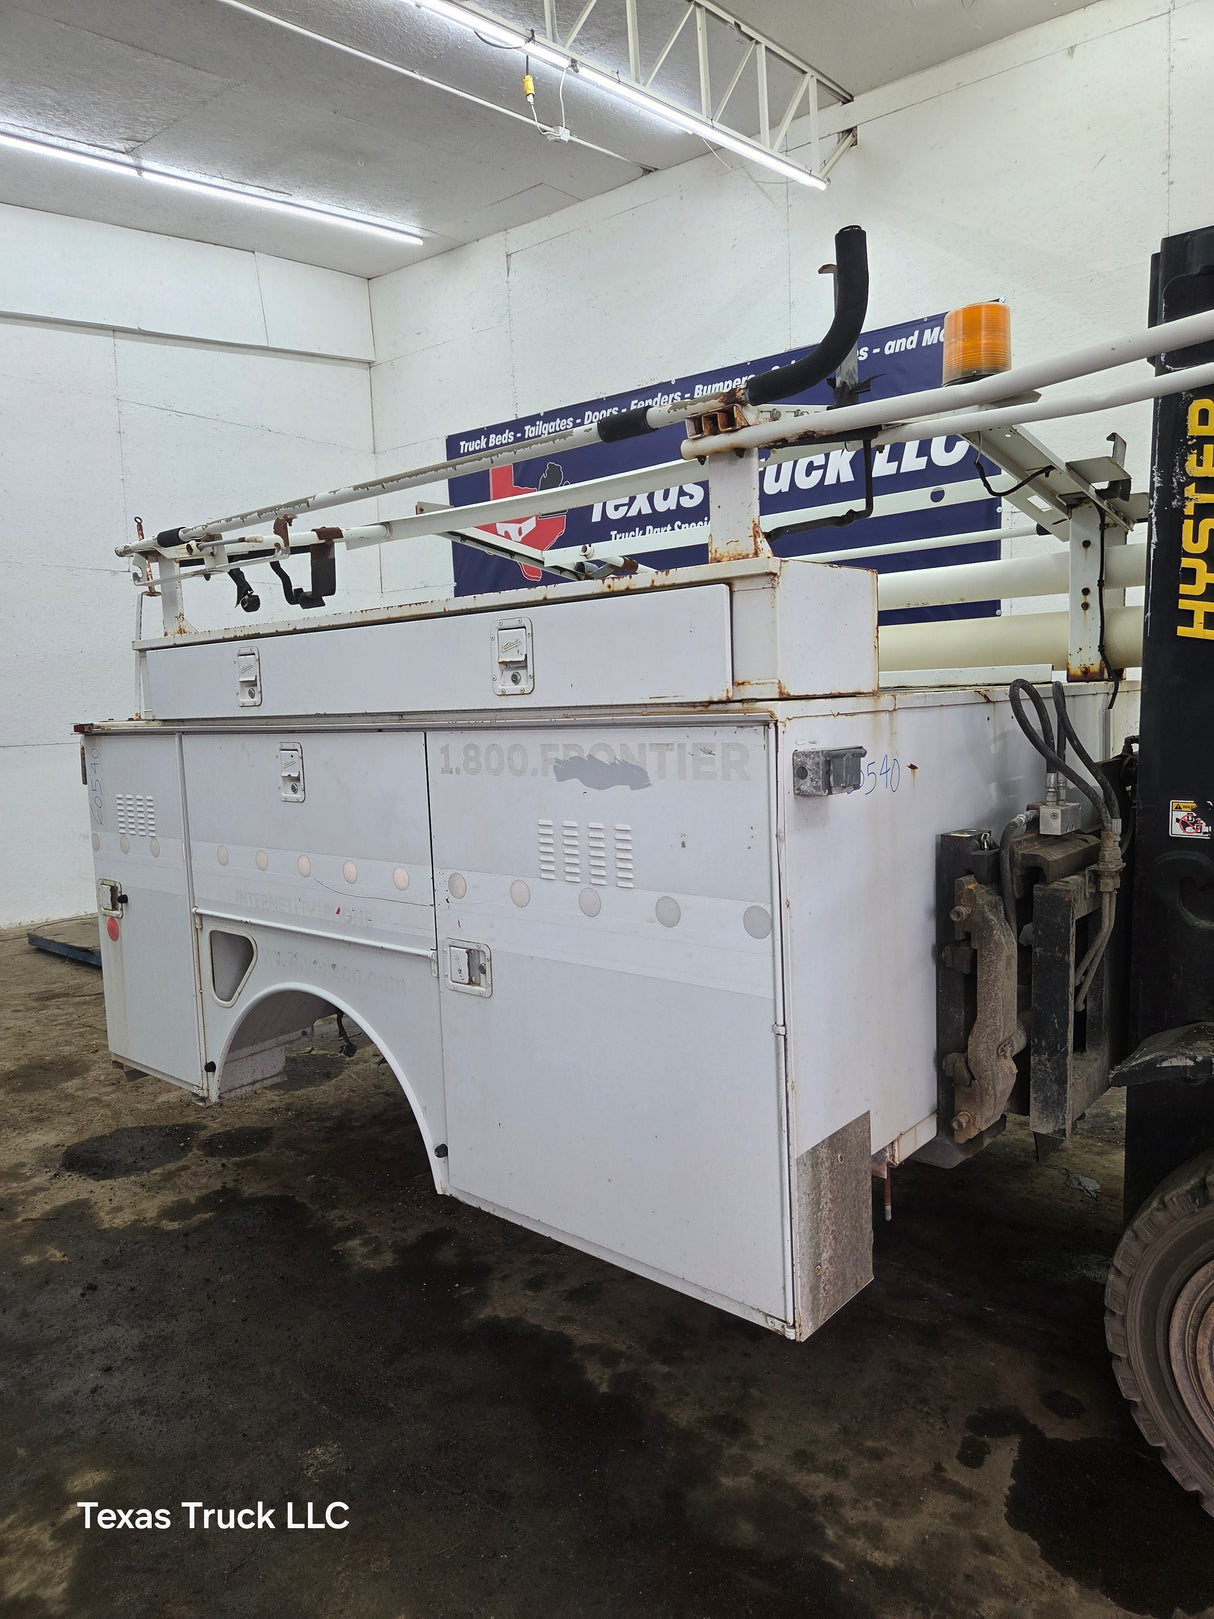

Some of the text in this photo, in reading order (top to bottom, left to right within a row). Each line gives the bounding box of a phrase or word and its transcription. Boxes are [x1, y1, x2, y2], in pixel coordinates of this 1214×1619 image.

[459, 435, 487, 454] Truck
[488, 429, 515, 448] Beds
[524, 417, 574, 439] Tailgates
[584, 406, 619, 425] Doors
[630, 392, 682, 411] Fenders
[884, 329, 920, 356] and
[591, 435, 971, 523] Texas uck LLC
[860, 753, 902, 796] 540
